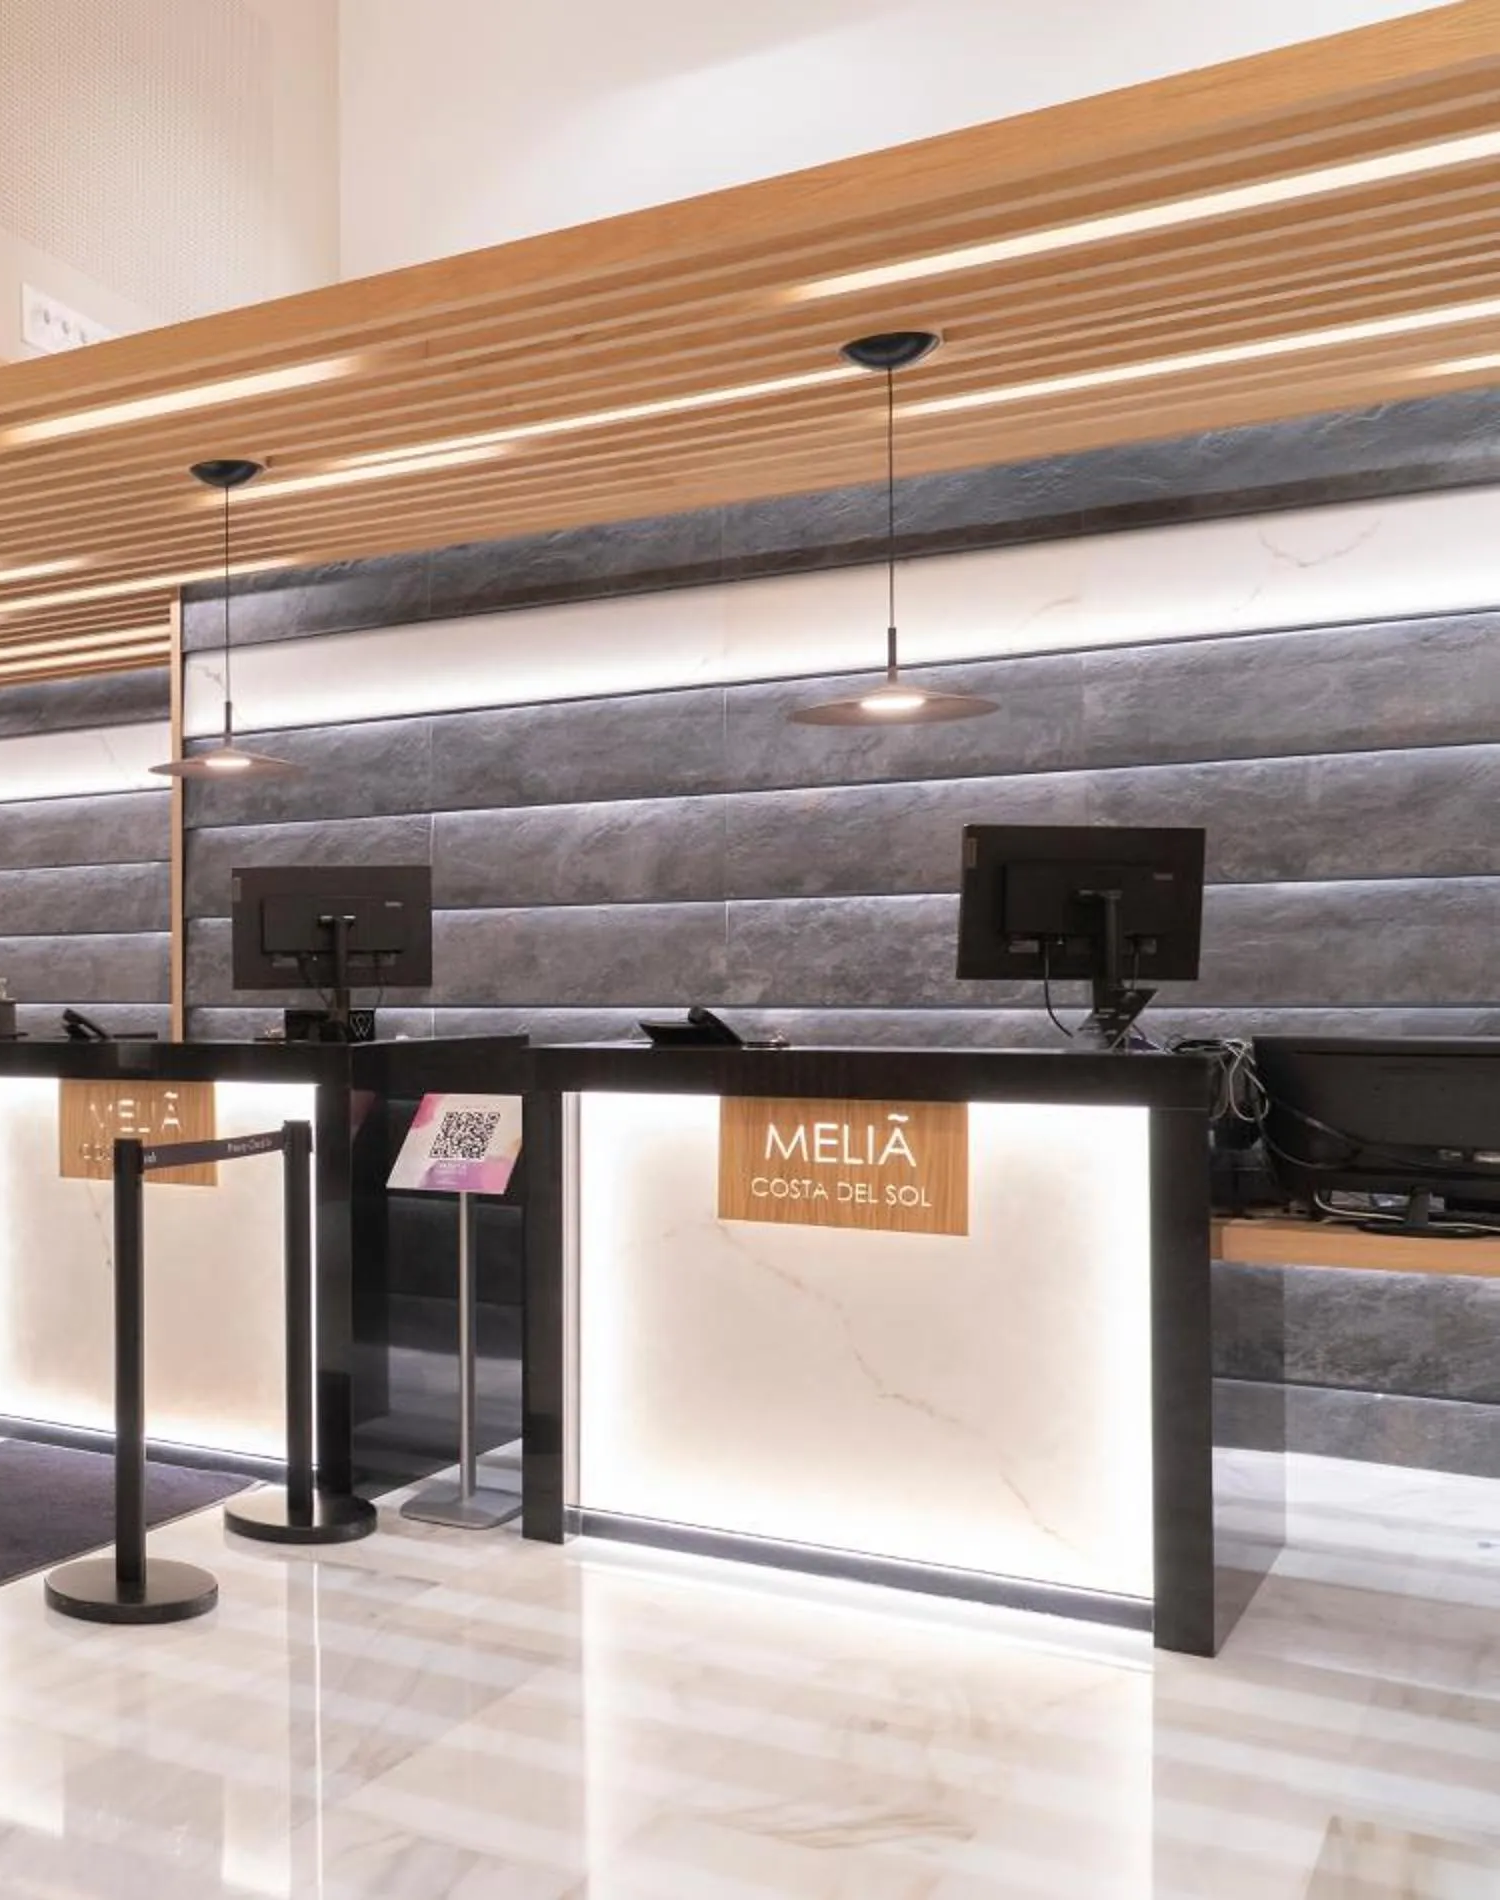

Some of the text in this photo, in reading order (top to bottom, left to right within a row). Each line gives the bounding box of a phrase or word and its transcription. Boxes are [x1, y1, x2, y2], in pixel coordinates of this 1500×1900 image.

[751, 1177, 933, 1208] COSTA DEL SOL
